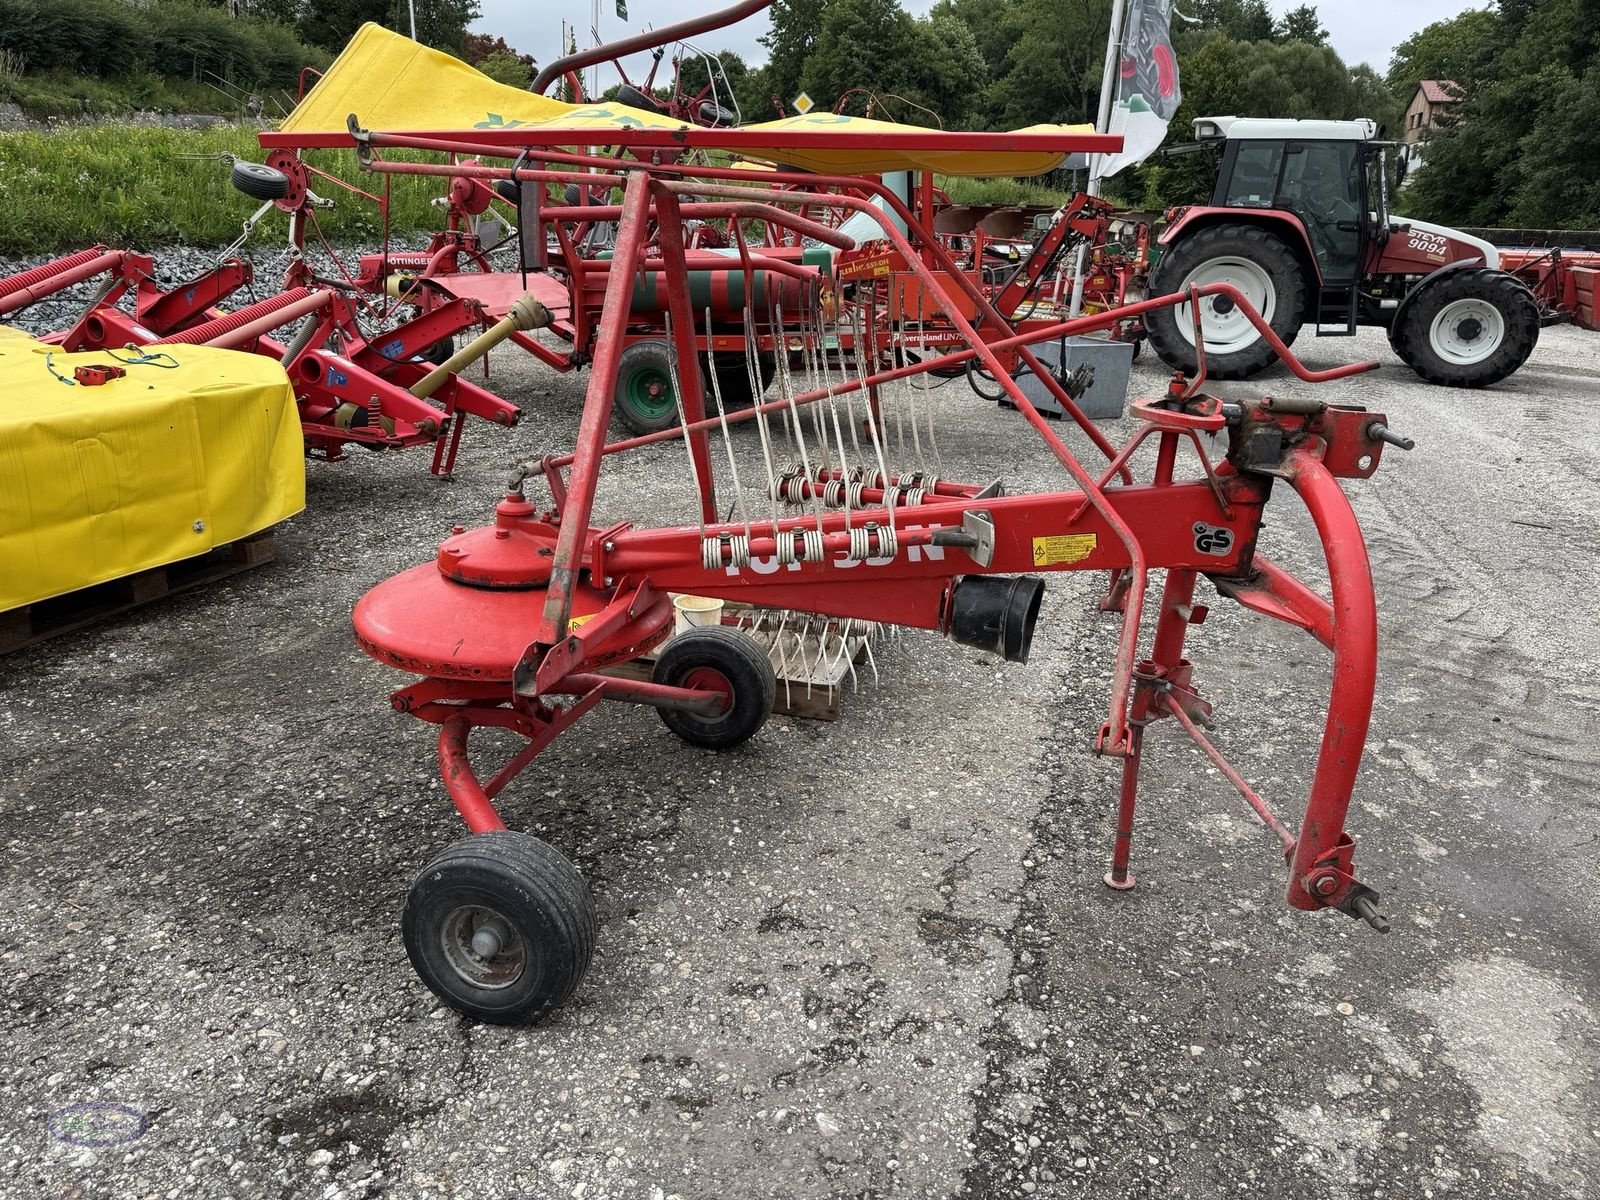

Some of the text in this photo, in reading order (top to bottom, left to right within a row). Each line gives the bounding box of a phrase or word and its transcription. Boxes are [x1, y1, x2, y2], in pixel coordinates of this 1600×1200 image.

[1408, 227, 1447, 245] STEYR
[1408, 238, 1447, 255] 9094
[1197, 530, 1230, 553] GS
